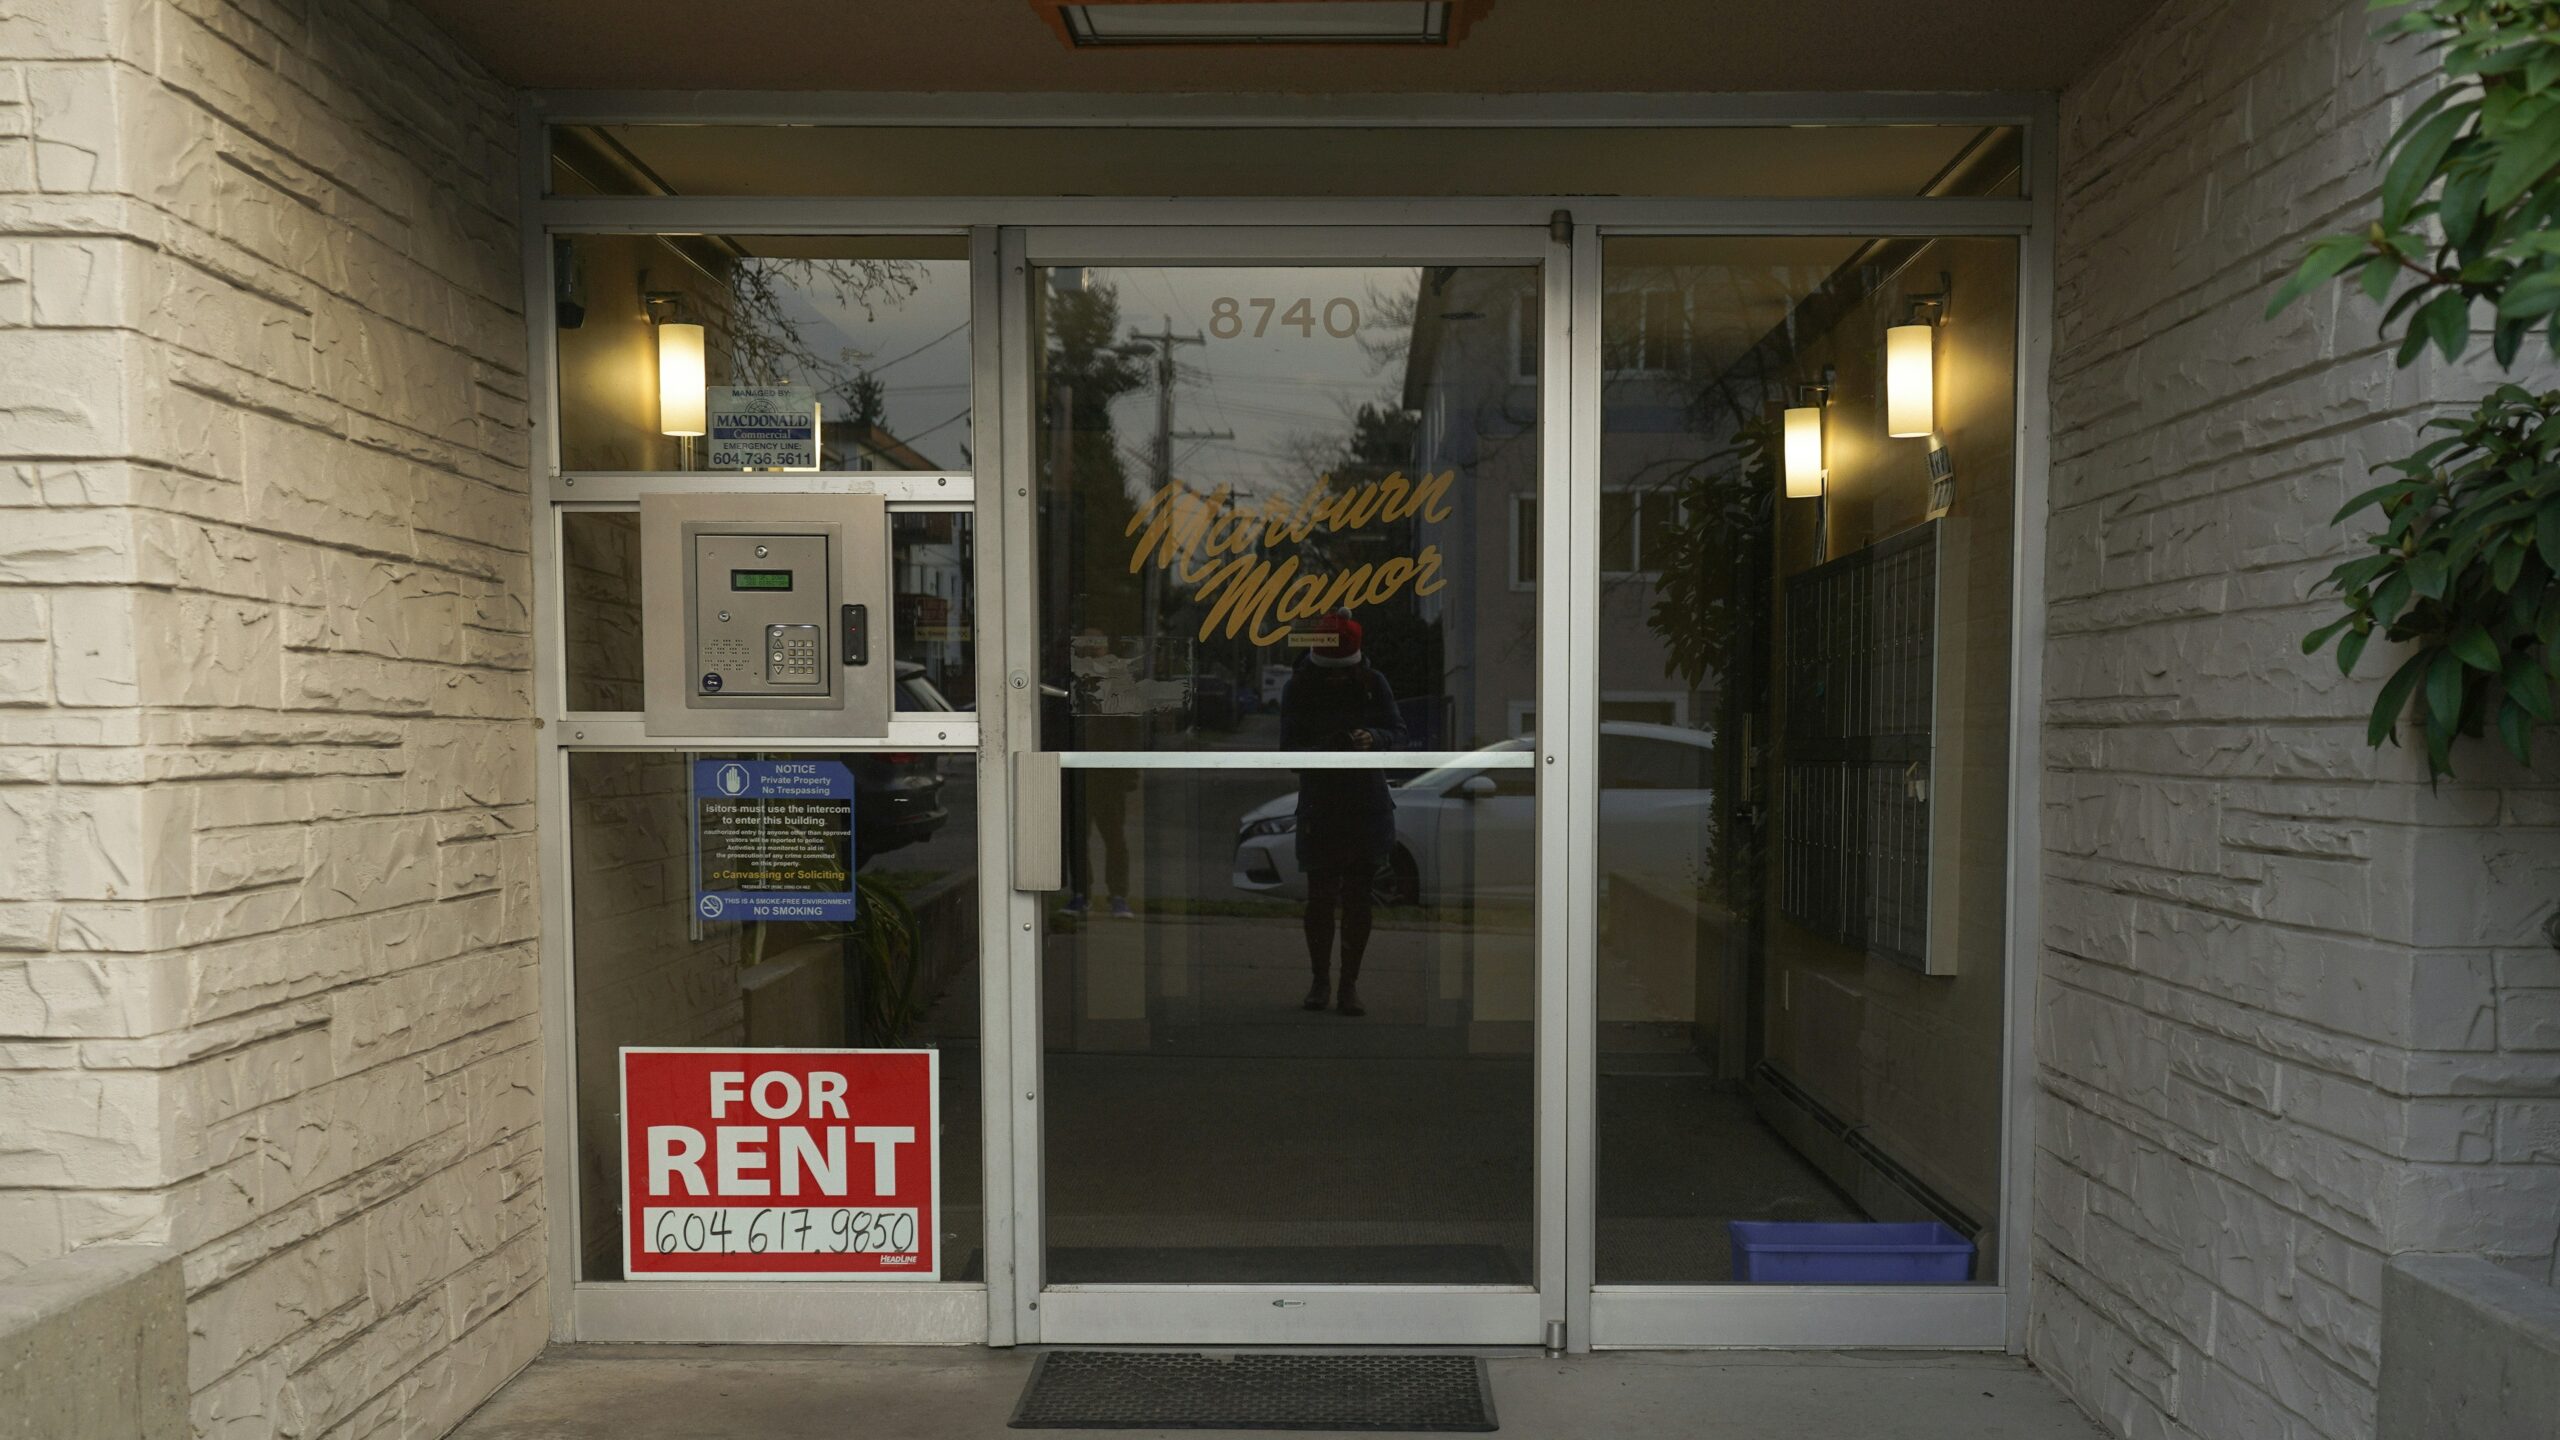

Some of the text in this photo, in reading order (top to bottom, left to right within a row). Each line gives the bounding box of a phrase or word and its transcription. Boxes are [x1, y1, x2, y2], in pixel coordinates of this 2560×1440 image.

[1208, 296, 1361, 339] 8740
[716, 415, 808, 427] MACDONALD
[733, 429, 791, 439] Commercial
[713, 453, 811, 465] 604.736.5611
[1125, 470, 1456, 584] Marburn
[1195, 544, 1448, 647] Manor
[775, 765, 816, 774] NOTICE
[761, 776, 831, 786] Private Property
[762, 786, 831, 796] No Trespassing
[740, 804, 765, 813] must
[788, 804, 804, 813] the
[806, 804, 850, 813] intercom
[722, 816, 732, 825] to
[735, 816, 761, 825] enter
[763, 816, 782, 825] this
[727, 852, 762, 860] prosecution
[722, 870, 782, 880] Canvassing
[797, 870, 845, 880] Soliciting
[753, 907, 823, 916] NO SMOKING
[709, 1070, 850, 1120] FOR
[647, 1125, 916, 1197] RENT
[655, 1208, 915, 1256] 604.617.9850
